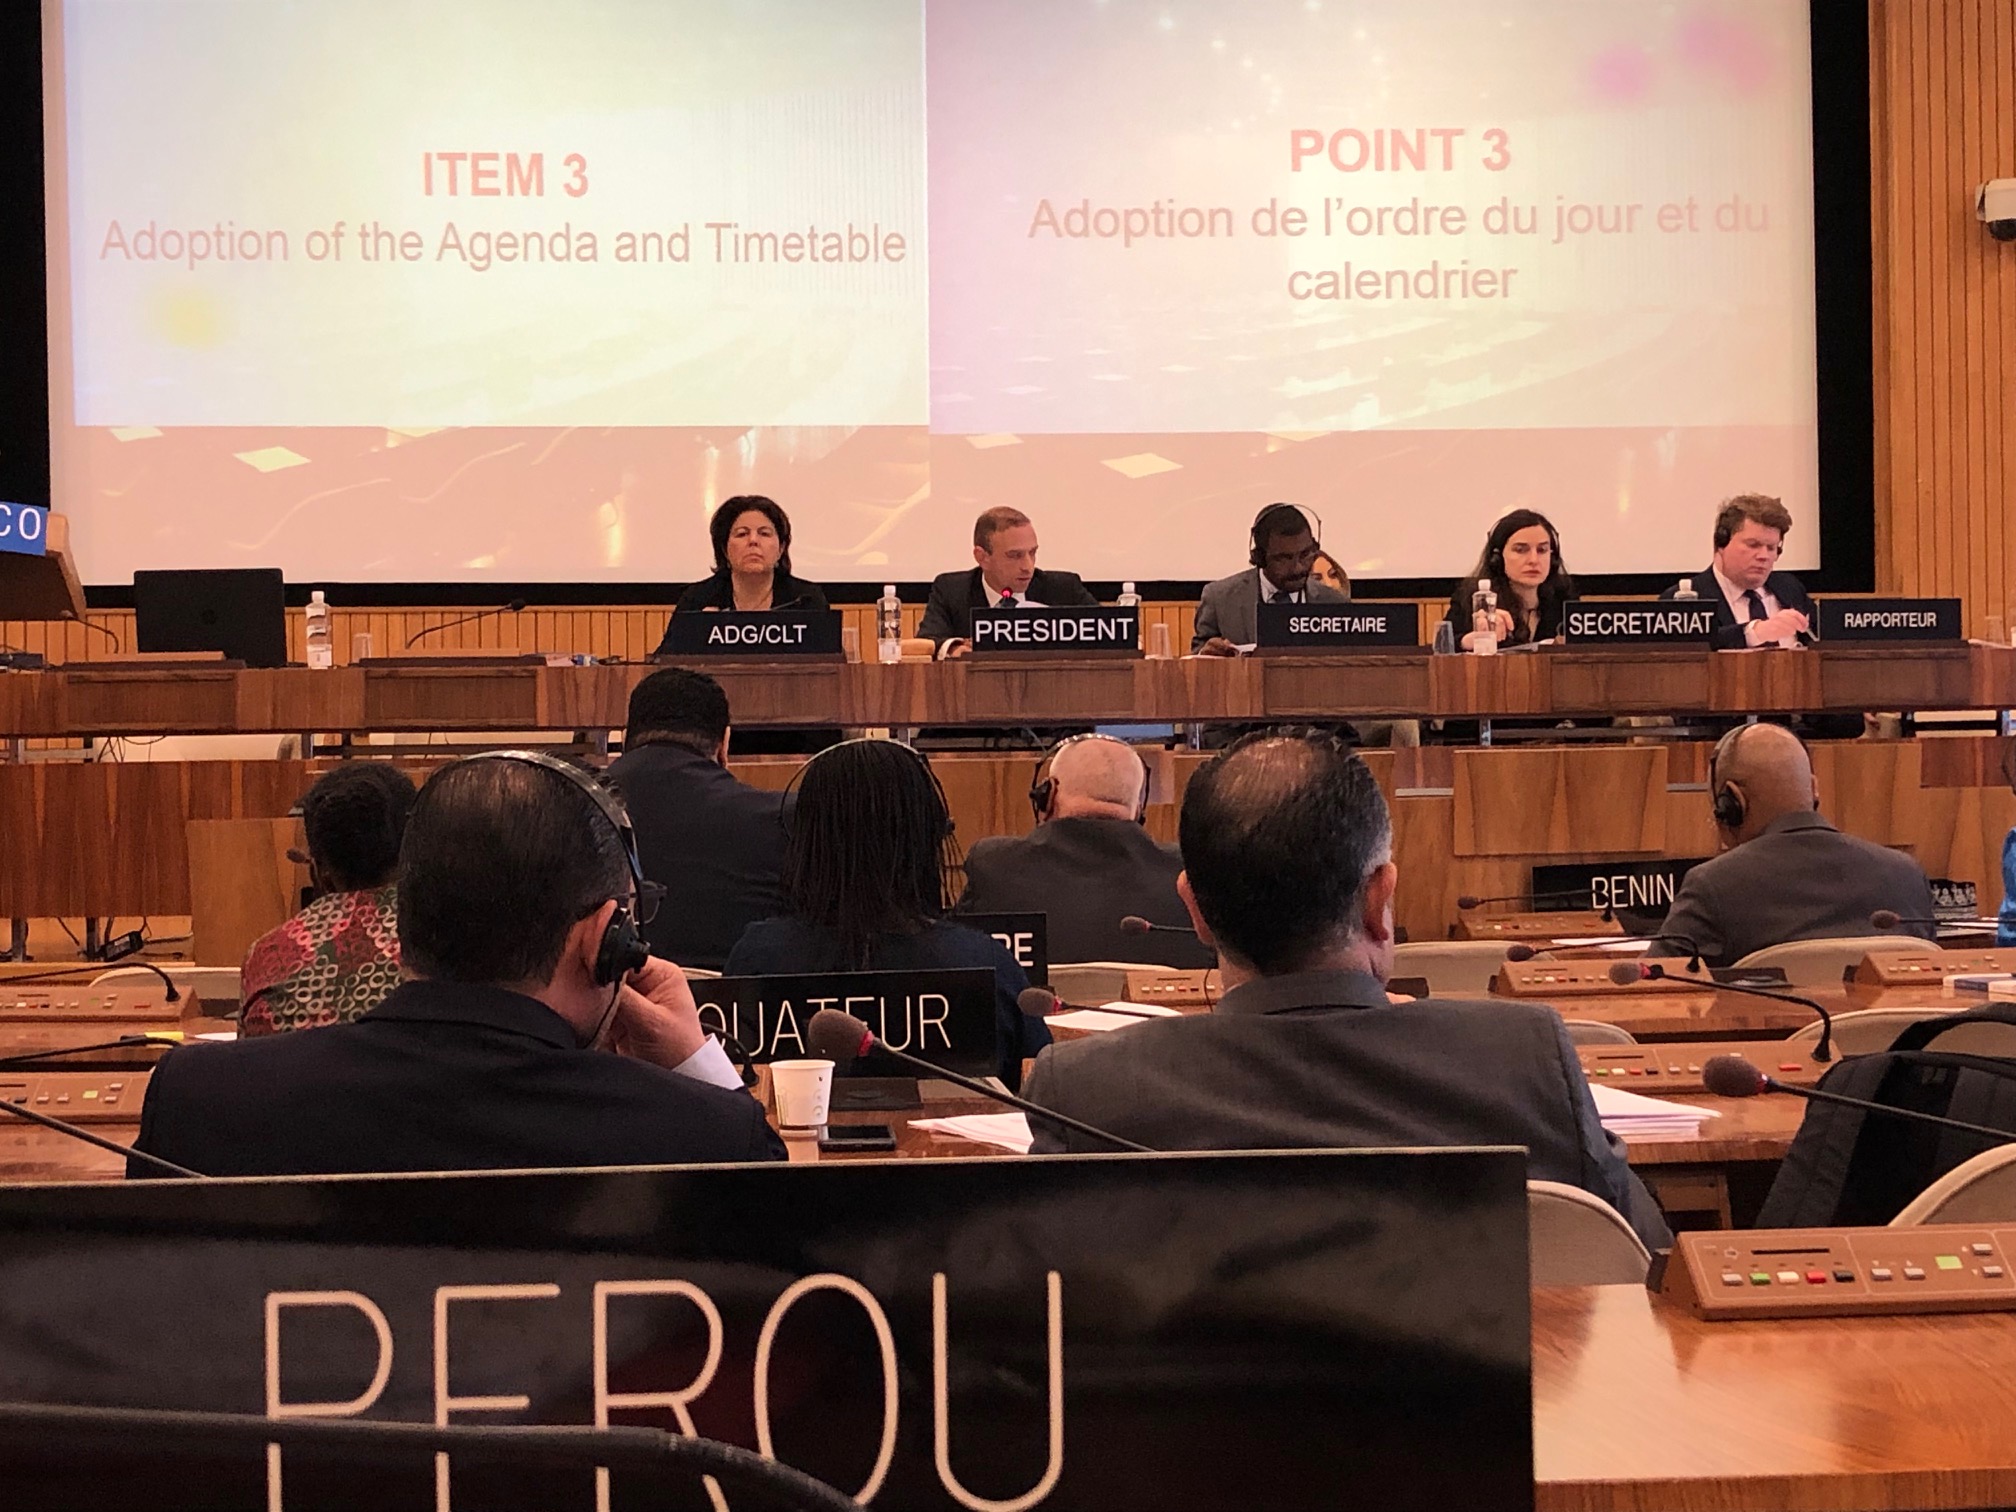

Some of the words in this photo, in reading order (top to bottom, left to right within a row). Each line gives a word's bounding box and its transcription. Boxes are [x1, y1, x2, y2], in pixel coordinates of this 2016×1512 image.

[1289, 128, 1464, 172] POINT
[1482, 128, 1511, 172] 3
[423, 152, 543, 196] ITEM
[563, 152, 589, 197] 3
[1028, 198, 1234, 248] Adoption
[1250, 197, 1307, 236] de
[1482, 196, 1537, 235] du
[1551, 196, 1643, 244] jour
[1656, 197, 1700, 233] et
[1714, 194, 1770, 233] du
[100, 221, 289, 270] Adoption
[304, 220, 346, 262] of
[358, 221, 424, 262] the
[436, 222, 599, 272] Agenda
[613, 222, 691, 263] and
[706, 222, 906, 263] Timetable
[1287, 261, 1518, 300] calendrier
[708, 624, 807, 644] ADG/CLT
[975, 618, 1134, 642] PRESIDENT
[1289, 617, 1387, 633] SECRETAIRE
[1569, 612, 1713, 635] SECRETARIAT
[1844, 612, 1937, 628] RAPPORTEUR
[1592, 873, 1674, 909] BENIN
[265, 1270, 1063, 1512] PEROU
